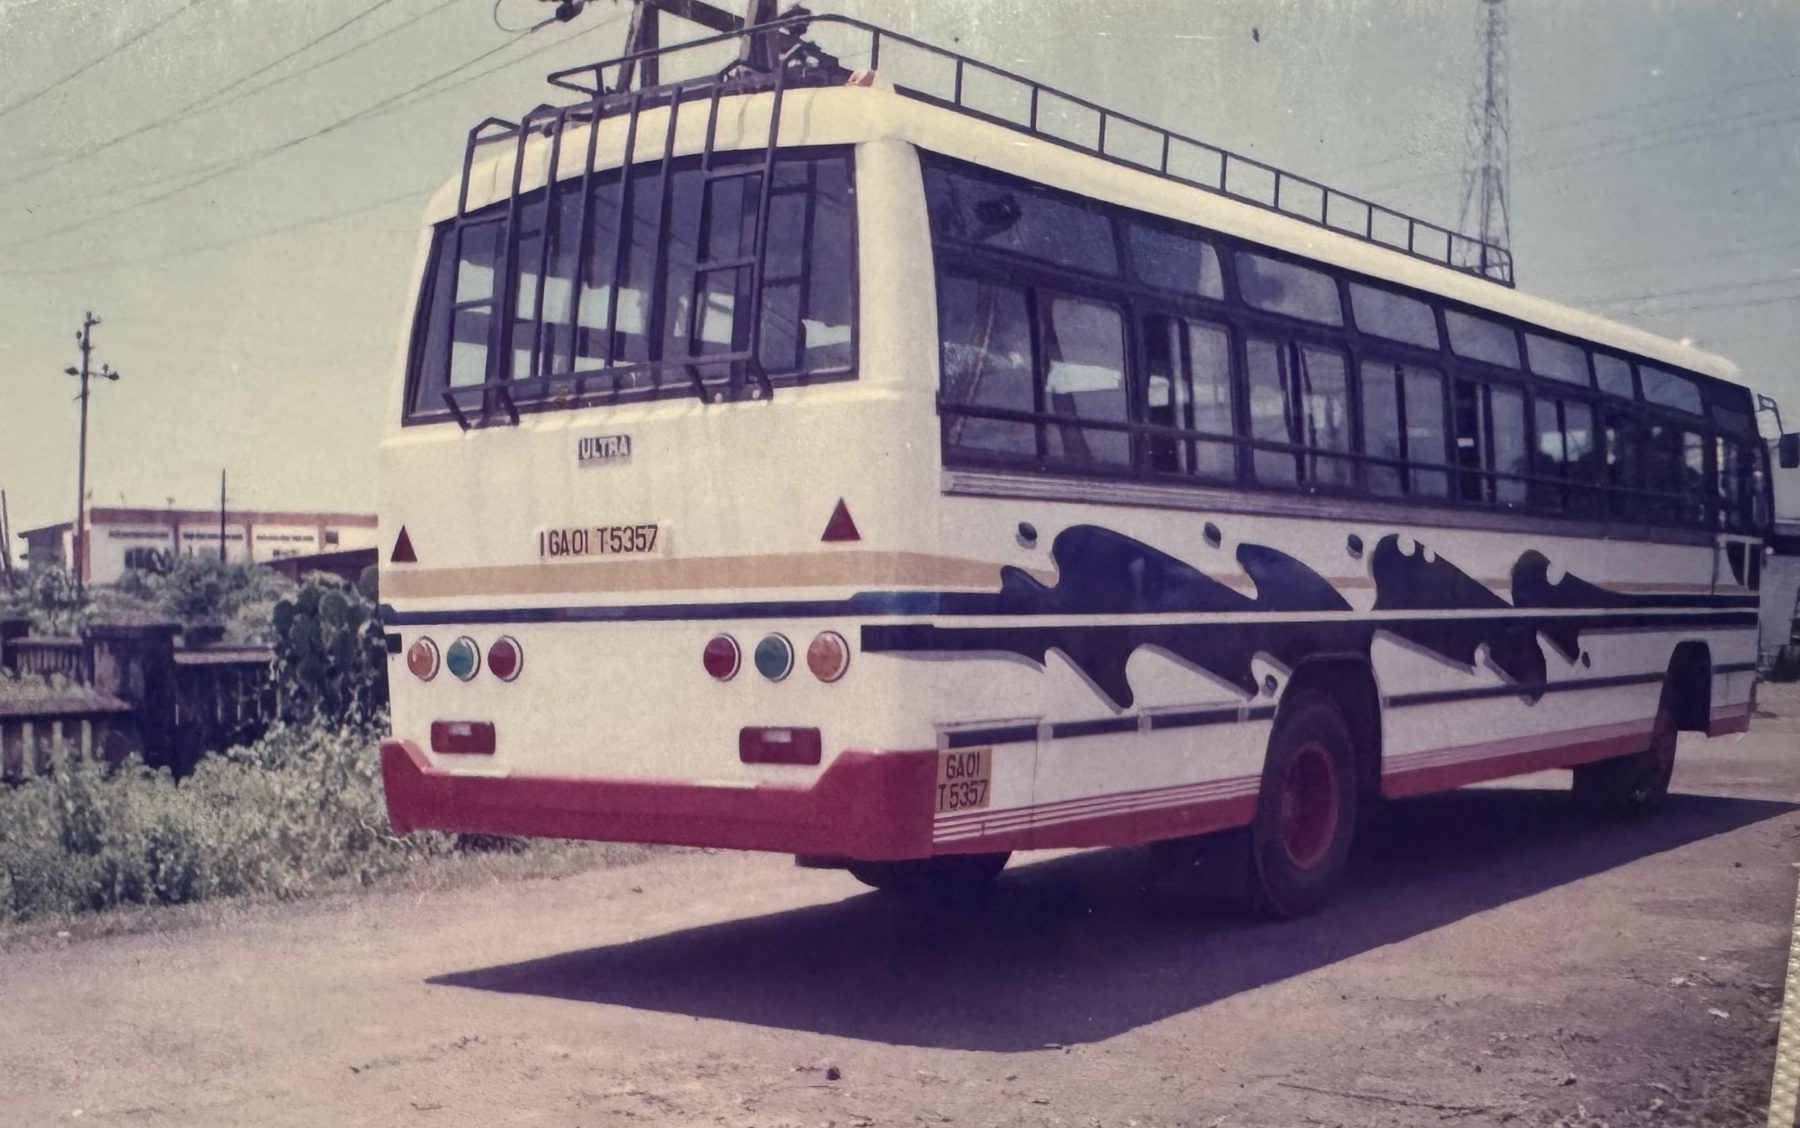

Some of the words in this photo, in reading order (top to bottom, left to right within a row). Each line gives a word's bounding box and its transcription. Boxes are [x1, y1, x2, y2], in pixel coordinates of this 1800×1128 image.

[578, 435, 631, 460] ULTRA
[596, 524, 658, 554] T5357
[946, 751, 980, 779] GA01
[938, 779, 988, 810] T5357
